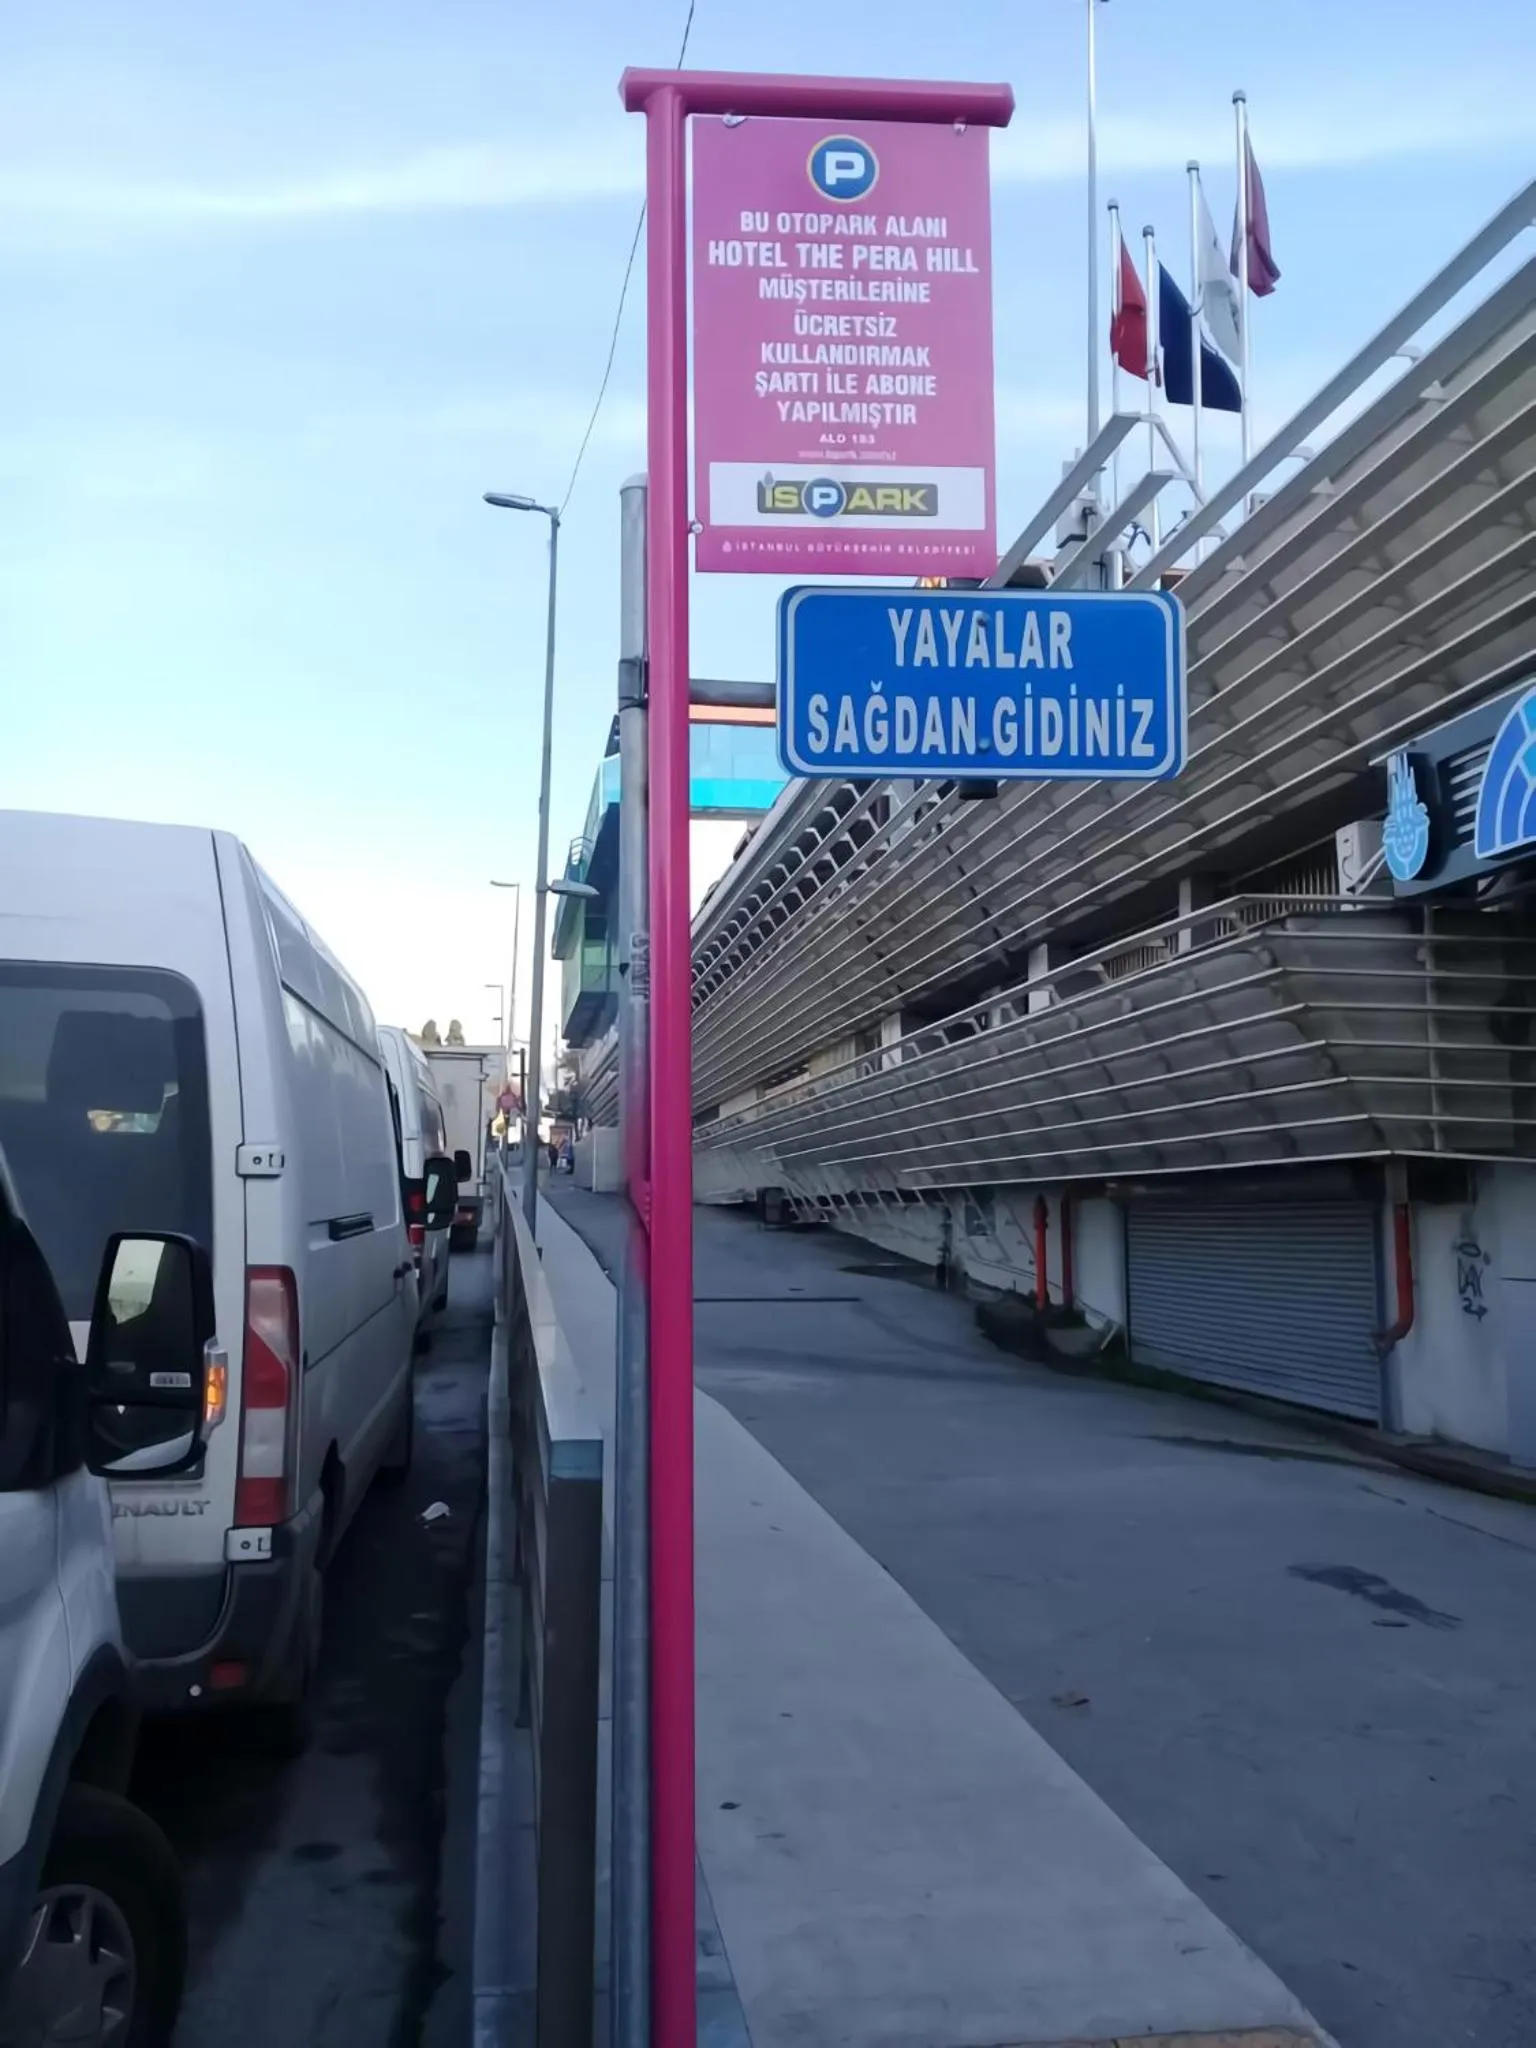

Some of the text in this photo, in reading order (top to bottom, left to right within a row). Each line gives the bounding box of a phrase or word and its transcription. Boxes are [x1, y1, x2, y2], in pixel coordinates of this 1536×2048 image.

[825, 151, 865, 185] P
[741, 212, 947, 238] BU OTOPARK ALANI
[709, 240, 979, 273] HOTEL THE PERA HILL
[759, 273, 931, 304] MÜŞTERİLERİNE
[794, 309, 897, 337] ÜCRETSİZ
[760, 342, 931, 367] KULLANDIRMAK
[755, 367, 937, 397] ŞARTI İLE ABONE
[776, 401, 917, 429] YAPILMIŞTIR
[819, 433, 846, 444] ALO
[887, 608, 1074, 669] YAYALAR
[807, 680, 1155, 757] SAĞDAN GİDİNİZ
